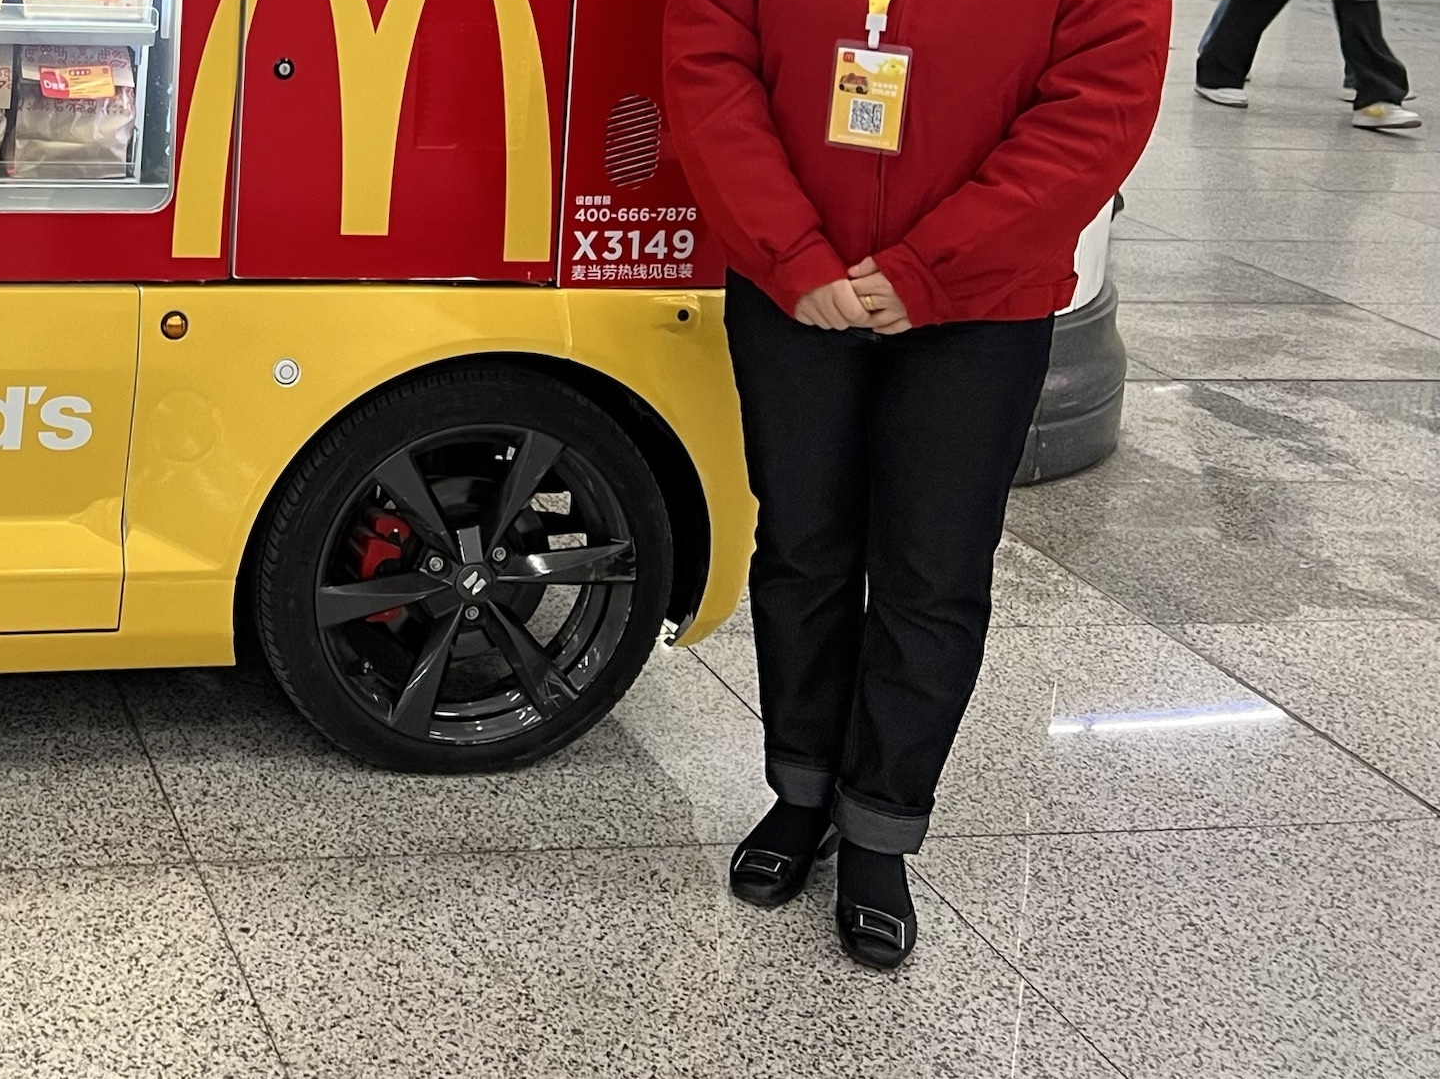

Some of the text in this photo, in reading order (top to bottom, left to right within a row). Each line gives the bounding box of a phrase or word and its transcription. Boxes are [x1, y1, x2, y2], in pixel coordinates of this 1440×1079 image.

[575, 207, 697, 222] 400-666-7876
[572, 229, 695, 261] X3149
[571, 263, 693, 281] 麦当劳热线见包装
